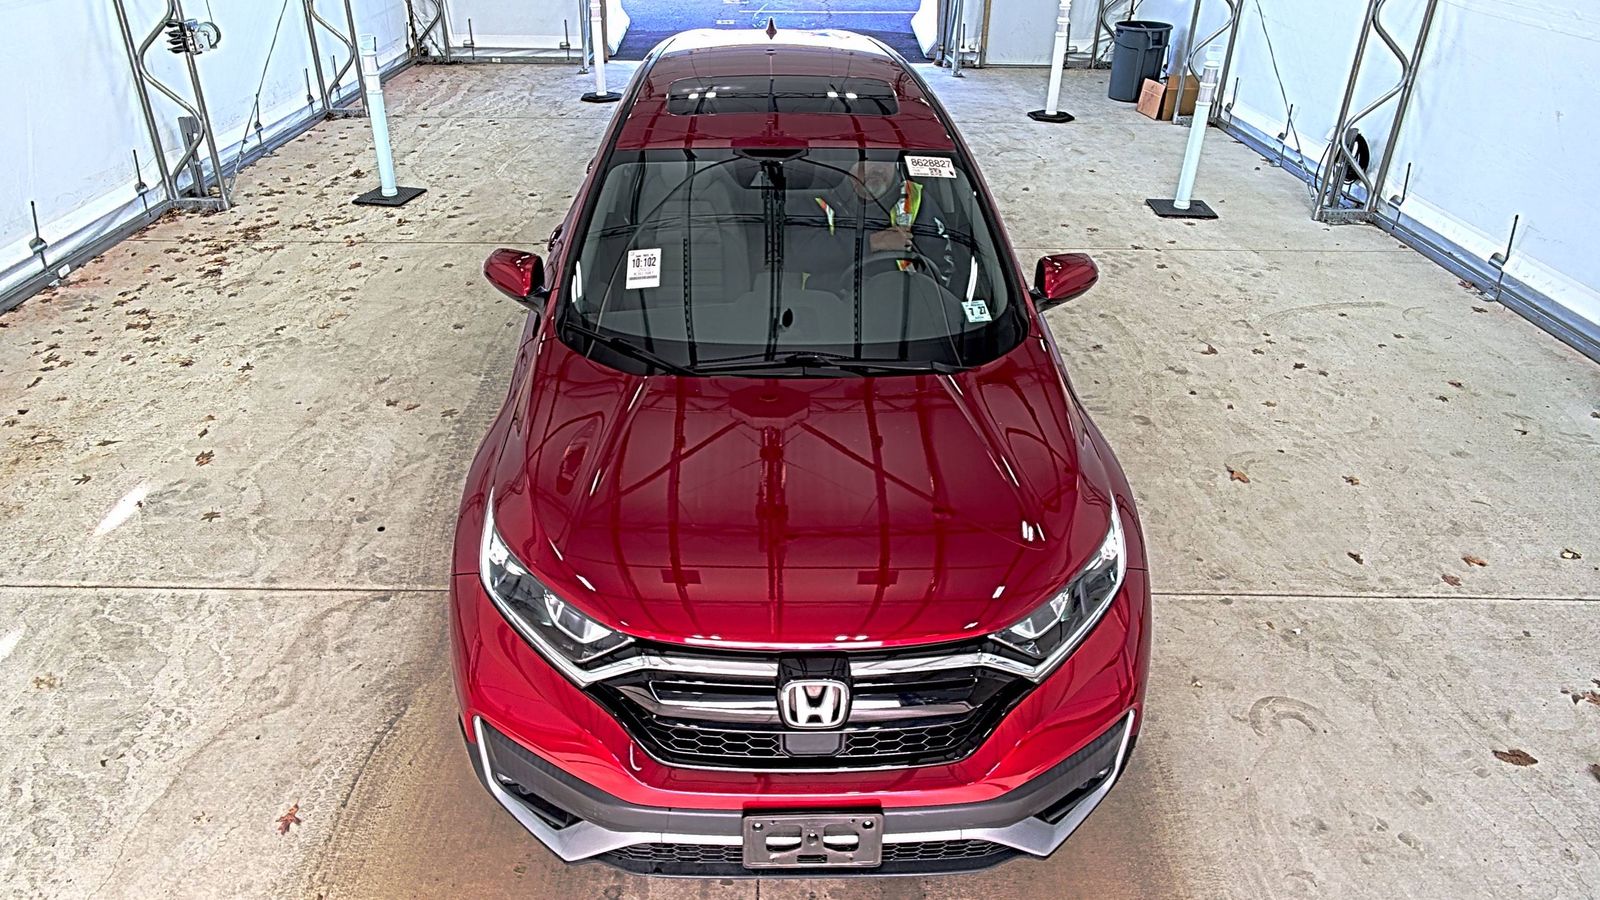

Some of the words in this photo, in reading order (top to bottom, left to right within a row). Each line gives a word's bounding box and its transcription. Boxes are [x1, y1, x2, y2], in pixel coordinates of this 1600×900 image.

[910, 158, 951, 168] 8628827
[632, 256, 657, 268] 10:102
[968, 307, 974, 316] 7
